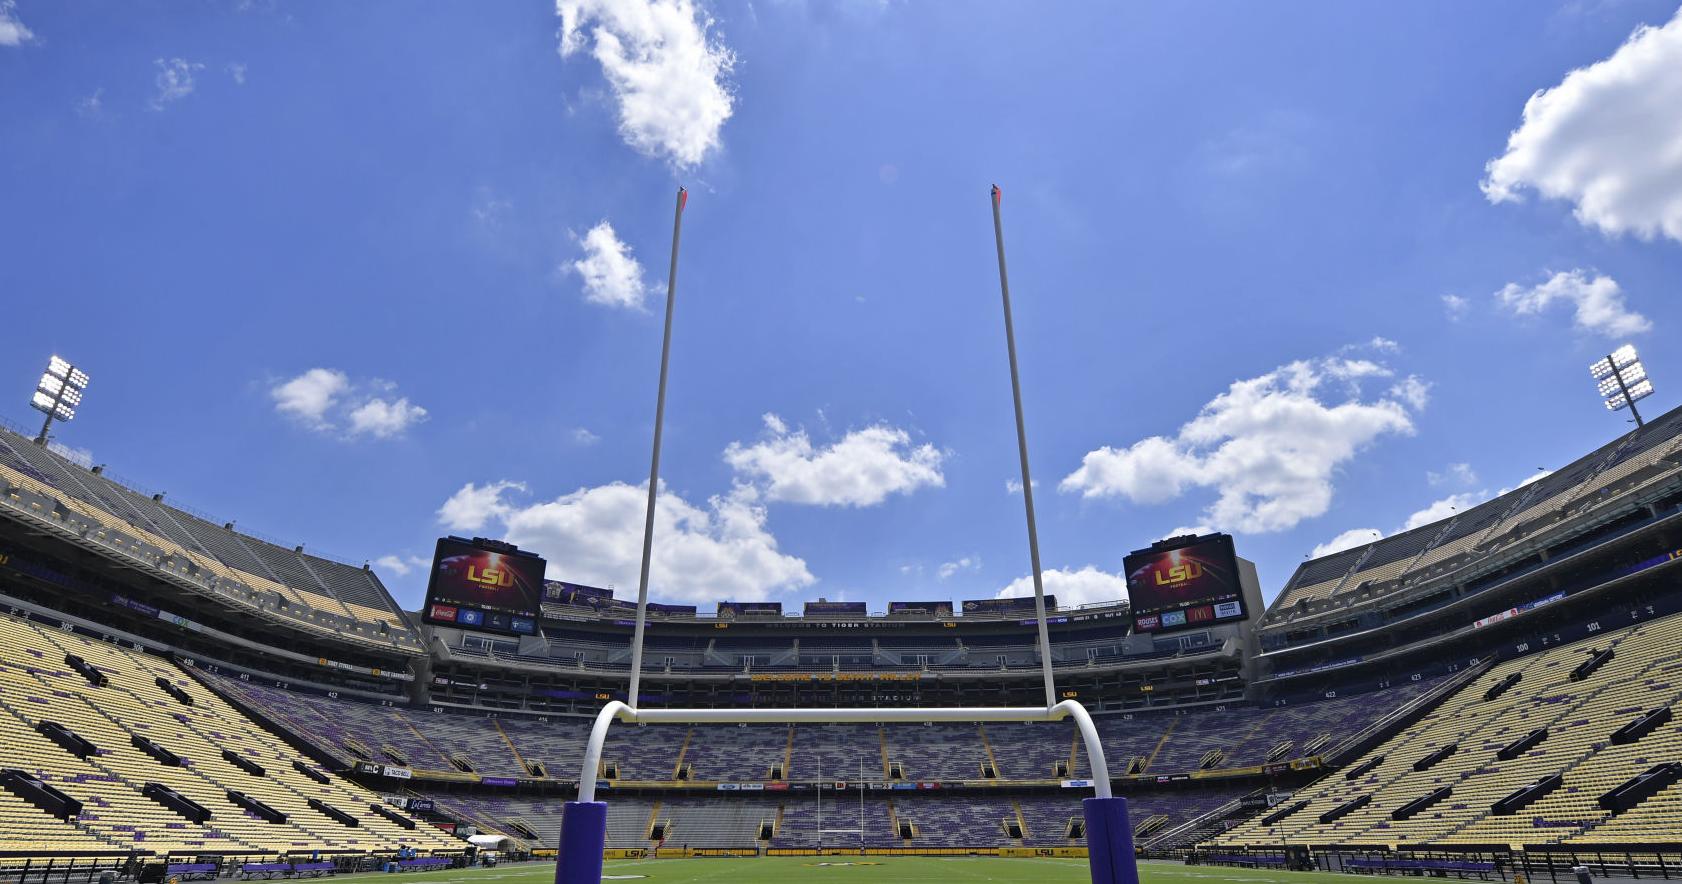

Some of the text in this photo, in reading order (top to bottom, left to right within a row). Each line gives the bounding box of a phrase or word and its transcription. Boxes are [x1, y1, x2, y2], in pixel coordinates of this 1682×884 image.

[467, 565, 514, 588] LSU
[1155, 562, 1203, 585] LSU
[1138, 616, 1158, 626] ROUSES
[1162, 613, 1187, 625] COX
[61, 621, 74, 632] 305
[1587, 621, 1601, 632] 101
[133, 643, 144, 653] 306
[1516, 643, 1529, 653] 100
[240, 673, 250, 681] 411
[328, 691, 338, 699] 412
